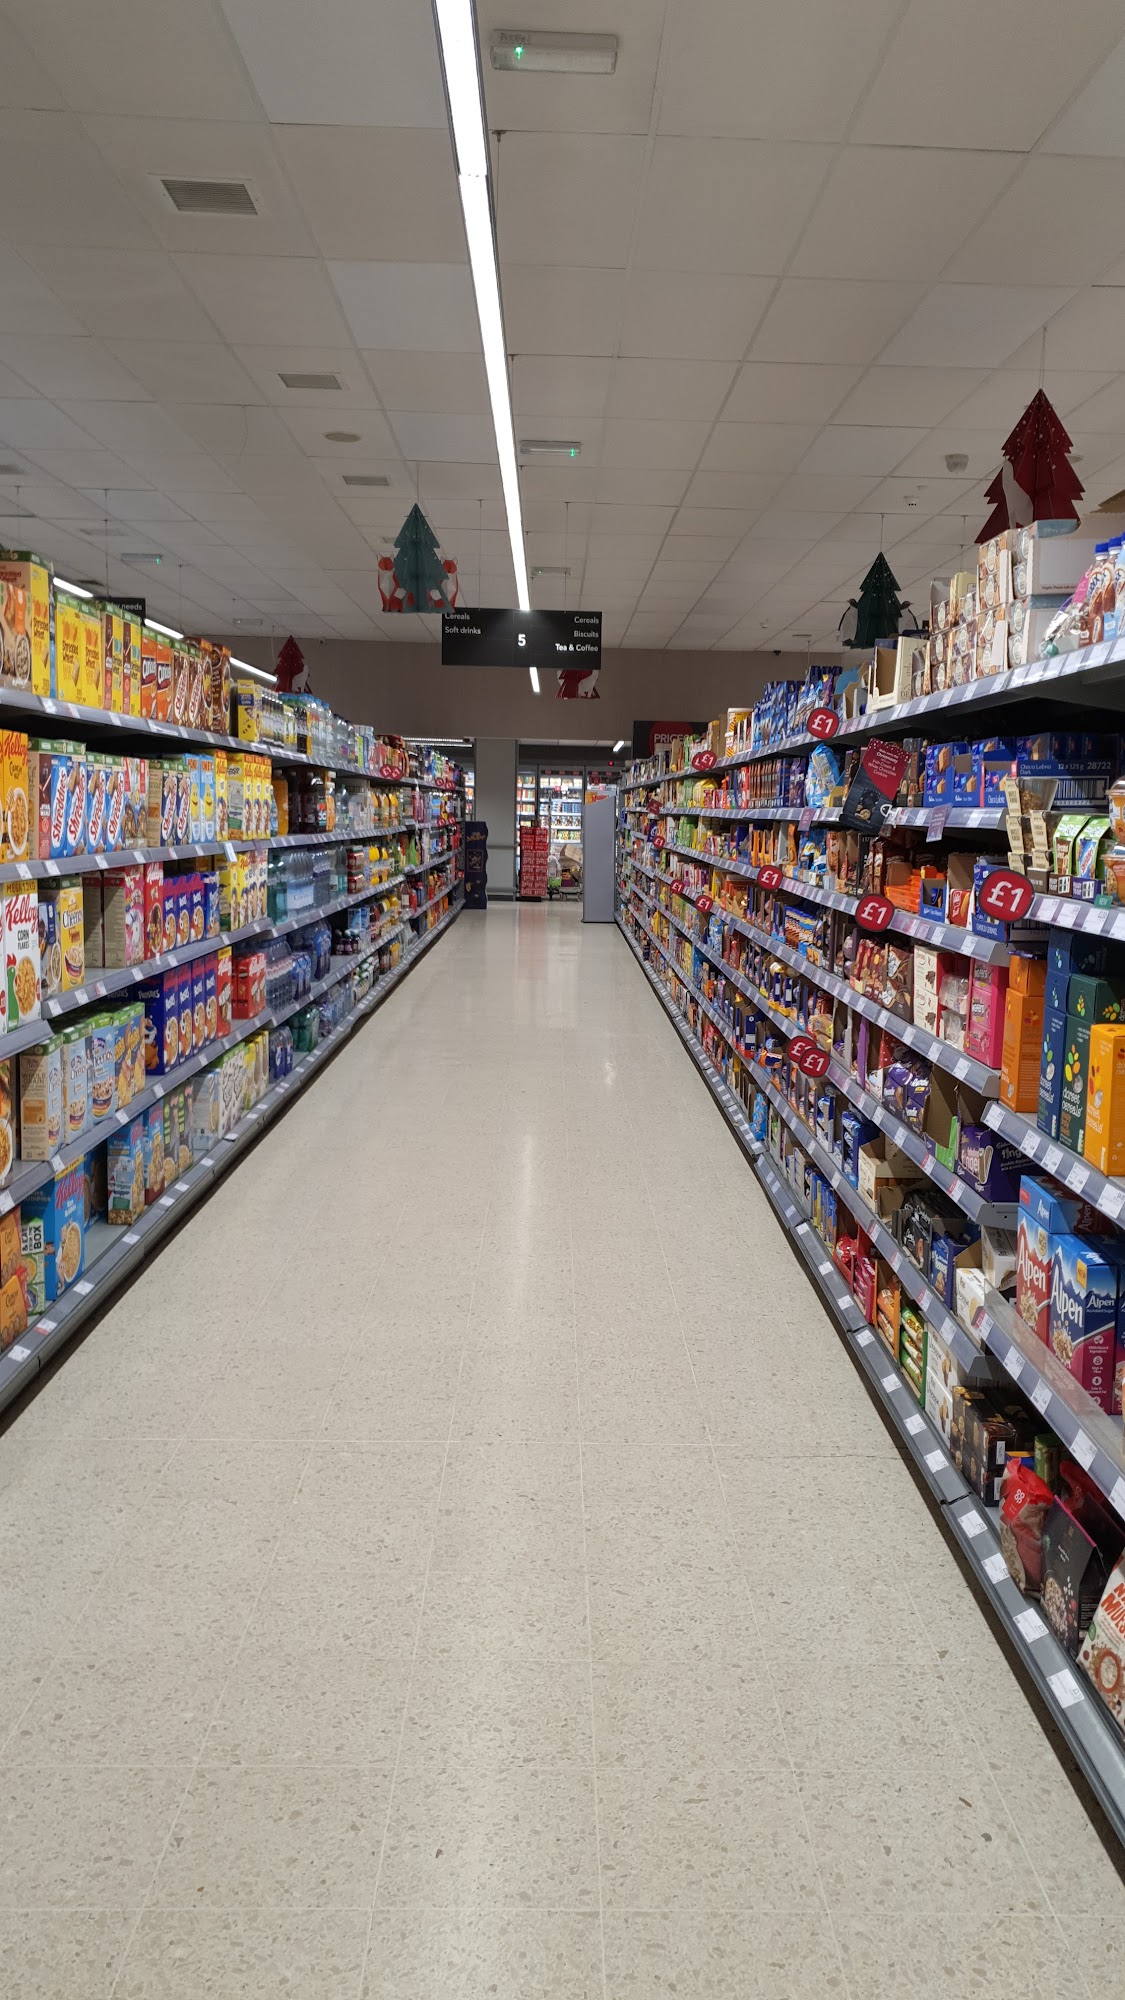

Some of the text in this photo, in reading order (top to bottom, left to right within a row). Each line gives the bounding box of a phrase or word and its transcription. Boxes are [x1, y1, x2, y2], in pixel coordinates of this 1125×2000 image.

[121, 603, 142, 611] needs
[460, 627, 481, 635] drinks
[574, 630, 599, 638] Biscuits
[517, 633, 527, 646] 5
[555, 643, 567, 651] Tea
[576, 644, 599, 652] Coffee
[812, 715, 833, 734] £1
[702, 754, 714, 766] £1
[1087, 762, 1112, 770] 28722
[654, 838, 663, 847] £1
[761, 870, 779, 886] £1
[672, 882, 682, 892] £1
[986, 881, 1025, 912] £1
[697, 898, 710, 910] £1
[861, 902, 887, 924] £1
[18, 929, 29, 941] CORN
[804, 1054, 825, 1072] £1
[1062, 1086, 1080, 1104] dorset
[1062, 1100, 1083, 1118] cereals
[1002, 1148, 1022, 1159] fing
[1037, 1199, 1049, 1220] Alpen
[1078, 1204, 1094, 1232] Alpen
[33, 1225, 42, 1250] BOX
[1017, 1234, 1046, 1292] Alpen
[1077, 1267, 1086, 1277] NEW
[1050, 1265, 1084, 1328] Alpen
[1086, 1295, 1115, 1309] Alpen
[1101, 1592, 1125, 1639] MUES
